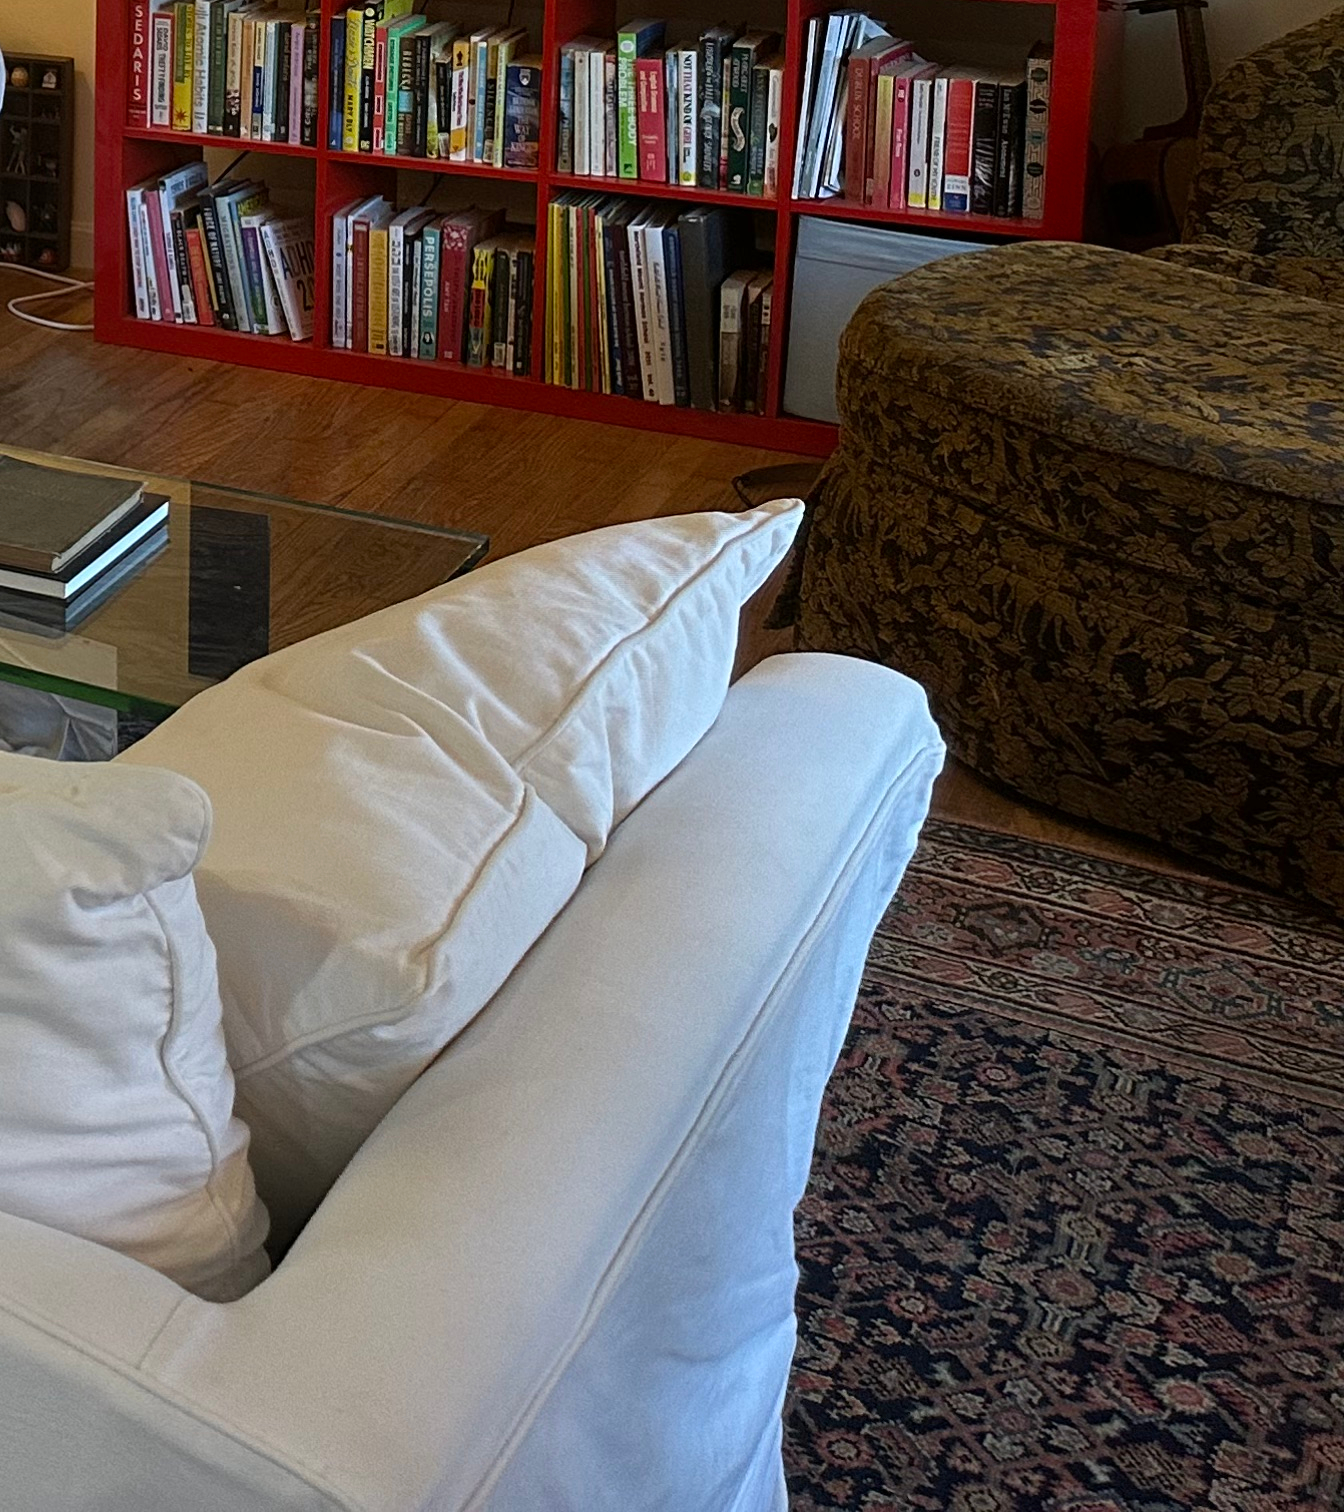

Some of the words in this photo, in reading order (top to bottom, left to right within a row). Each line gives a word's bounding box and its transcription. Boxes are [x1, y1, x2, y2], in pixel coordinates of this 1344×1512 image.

[132, 5, 144, 101] SEDARIS
[195, 23, 207, 66] Atomic
[363, 19, 375, 70] WATCHMEN
[401, 50, 412, 90] REBECCA
[628, 59, 636, 77] THE
[684, 55, 692, 69] NOT
[732, 59, 741, 88] ATWOOD
[740, 53, 749, 93] MARGARET
[194, 70, 206, 107] Habits
[619, 58, 628, 107] PROBLEM
[649, 71, 658, 90] English
[684, 72, 692, 92] THAT
[854, 68, 864, 101] DUBLIN
[1004, 89, 1012, 101] Ian
[485, 82, 495, 131] SILENCE
[628, 81, 637, 145] THREE-BODY
[650, 90, 658, 113] Grammar
[684, 94, 692, 114] KIND
[683, 127, 692, 144] GIRL
[684, 115, 692, 124] OF
[852, 104, 863, 140] SCHOOL
[1000, 139, 1009, 178] Atonement
[203, 207, 216, 231] FORCE
[208, 231, 218, 242] OF
[422, 237, 437, 317] PERSEPOLIS
